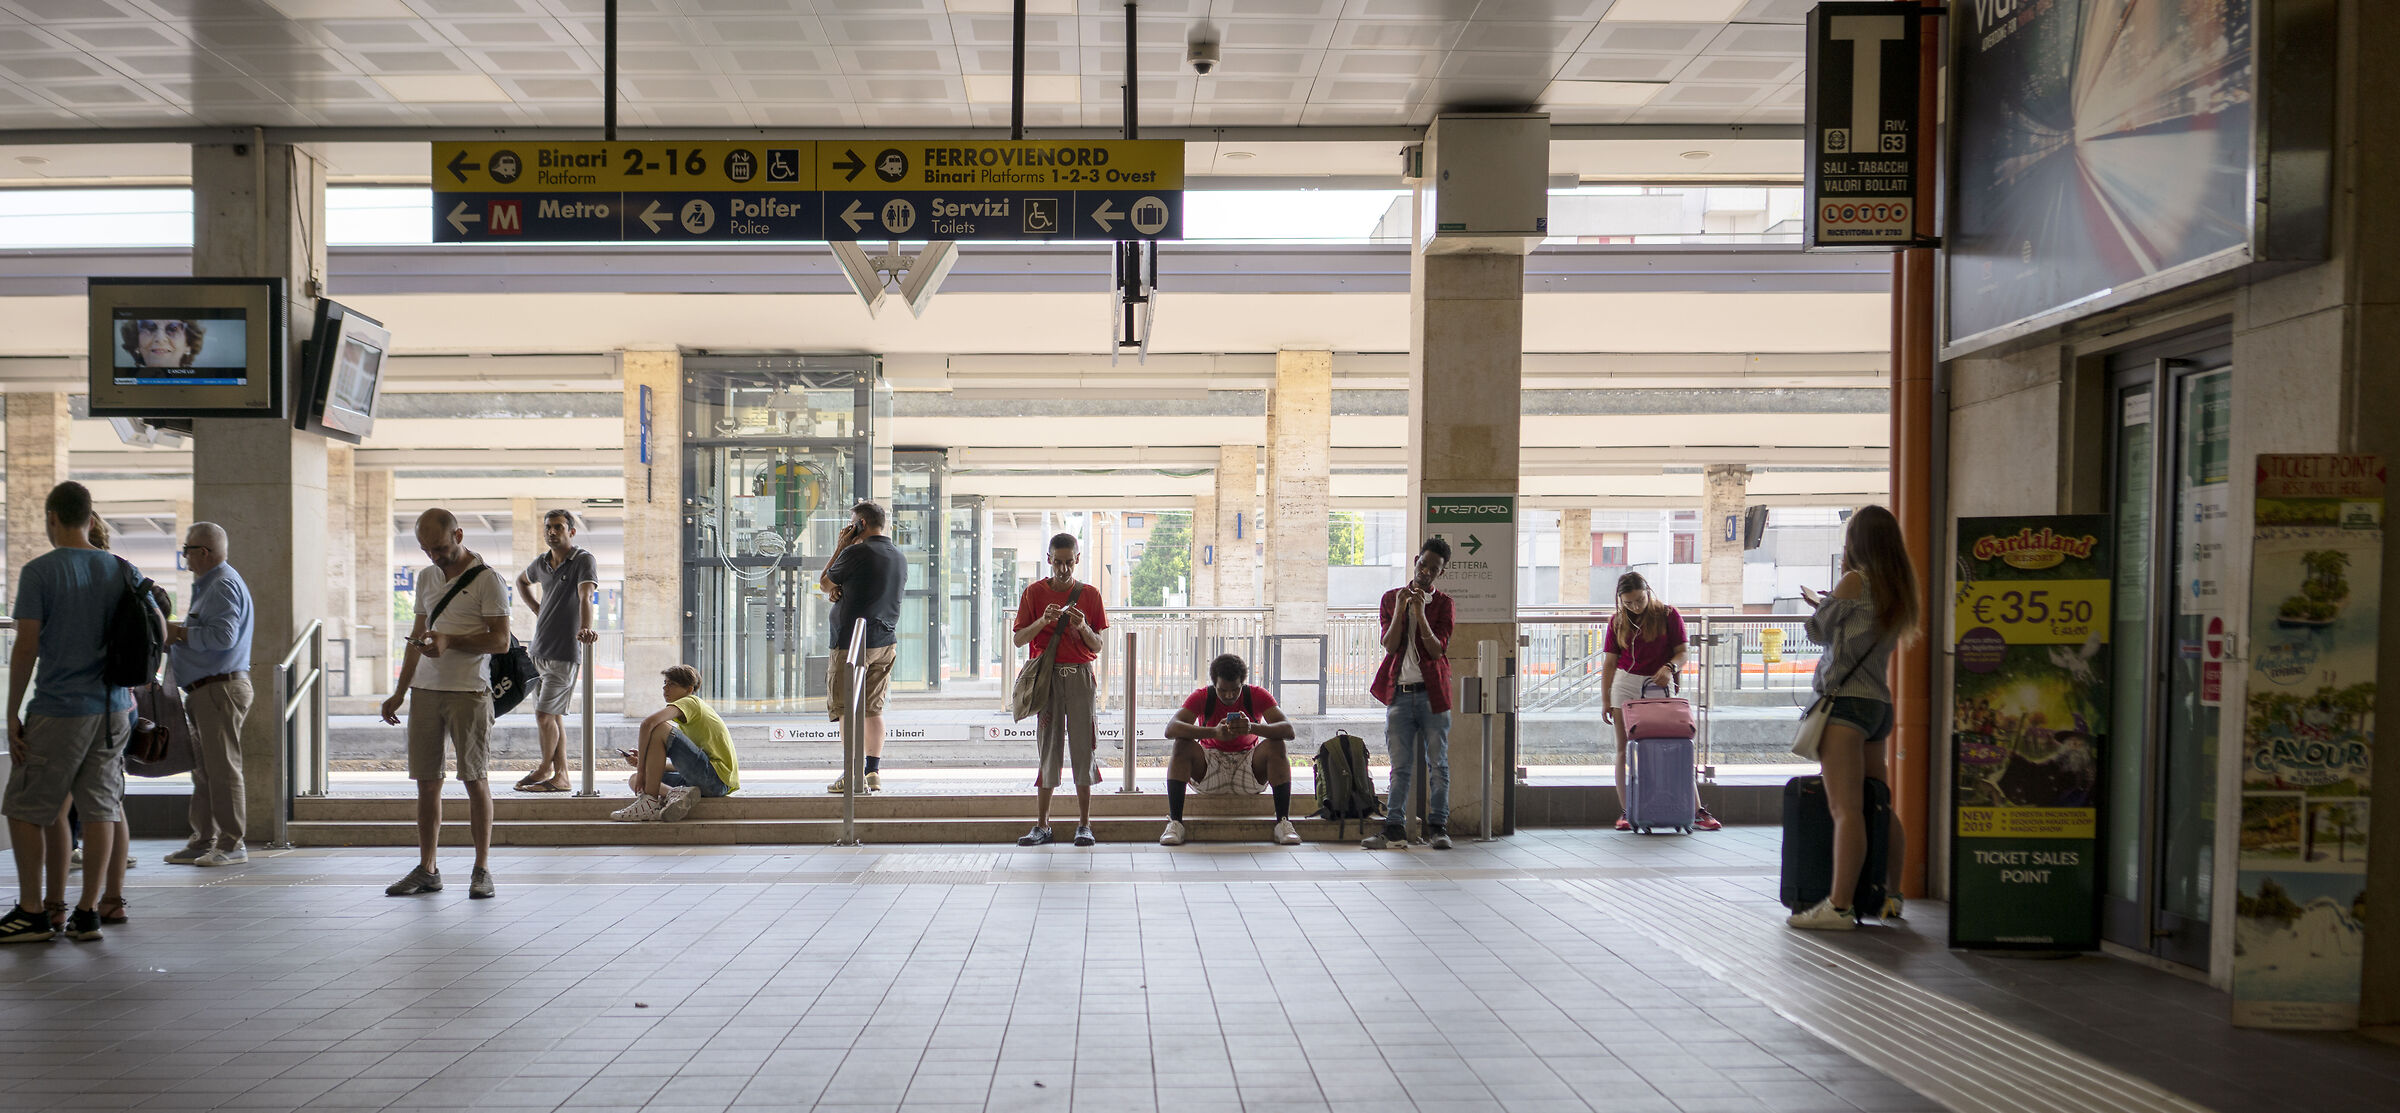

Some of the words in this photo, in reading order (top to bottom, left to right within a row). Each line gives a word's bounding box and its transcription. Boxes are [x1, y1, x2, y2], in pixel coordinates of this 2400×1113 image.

[1830, 15, 1905, 153] T
[1885, 120, 1909, 131] RIV.
[1883, 136, 1904, 150] 63
[538, 149, 607, 168] Binari
[623, 149, 707, 176] 2-16
[925, 148, 1109, 167] FERROVIENORD
[1823, 161, 1847, 174] SALI
[1858, 161, 1908, 174] TABACCHI
[538, 171, 596, 185] Platform
[925, 170, 976, 183] Binari
[981, 169, 1044, 183] Platforms
[1052, 170, 1099, 183] 1-2-3
[1106, 170, 1157, 183] Ovest
[1824, 180, 1861, 192] VALORI
[1865, 179, 1907, 192] BOLLATI
[730, 199, 801, 218] Polfer
[931, 198, 1009, 217] Servizi
[491, 206, 519, 231] M
[538, 200, 610, 219] Metro
[730, 221, 770, 234] Police
[932, 220, 975, 234] Toilets
[1826, 229, 1873, 237] RICEVITORIA
[2271, 456, 2320, 478] TICKET
[2329, 456, 2377, 478] POINT
[1440, 505, 1509, 514] TRENORD
[1973, 528, 2097, 560] Gardaland
[1462, 571, 1493, 580] OFFICE
[789, 730, 825, 738] Vietato
[896, 729, 925, 737] binari
[1004, 729, 1017, 737] Do
[1020, 729, 1036, 737] not
[2254, 737, 2369, 773] CAVOUR
[1962, 811, 1993, 821] NEW
[1962, 822, 1993, 833] 2019
[1973, 850, 2029, 866] TICKET
[2031, 851, 2080, 866] SALES
[2000, 869, 2052, 885] POINT
